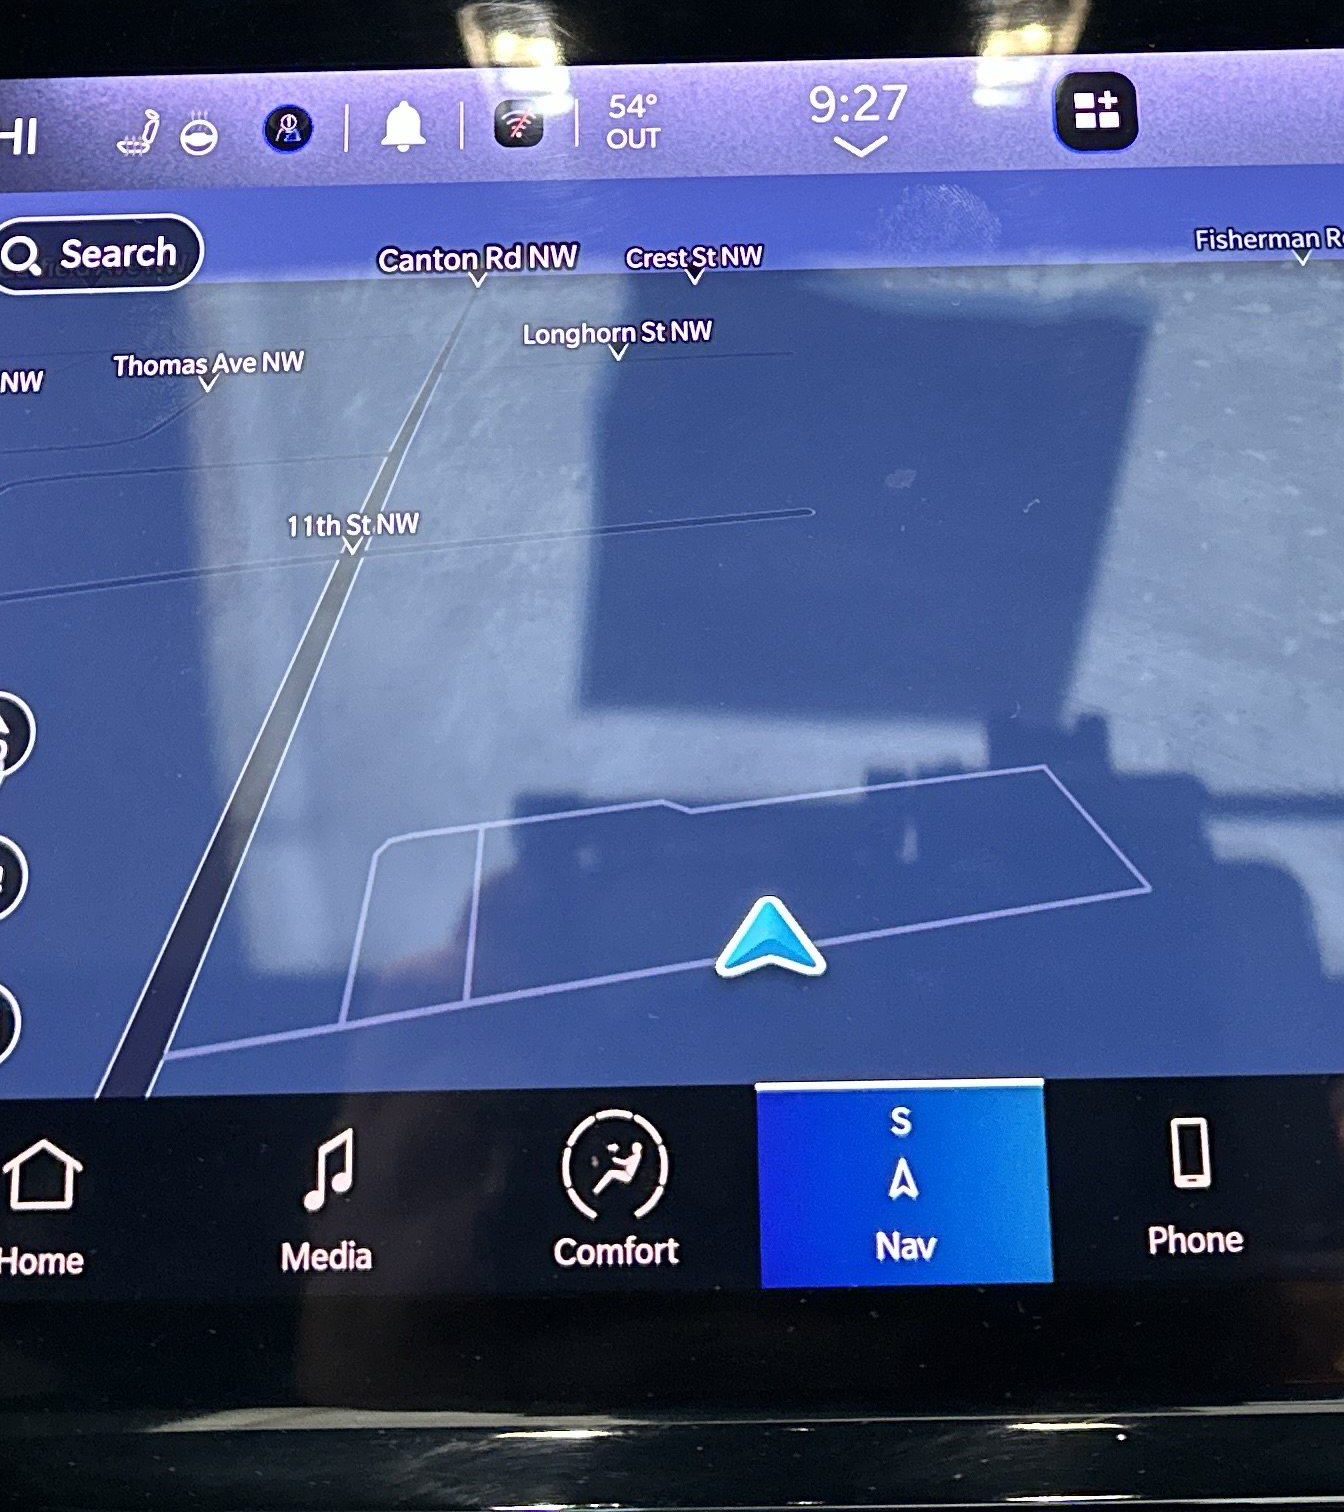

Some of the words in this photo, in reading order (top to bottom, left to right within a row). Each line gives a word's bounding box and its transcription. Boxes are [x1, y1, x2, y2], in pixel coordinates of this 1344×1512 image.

[607, 92, 659, 119] 54°
[808, 83, 908, 124] 9:27
[606, 127, 662, 150] OUT
[60, 235, 177, 269] Search
[1194, 227, 1320, 252] Fisherman
[377, 247, 478, 272] Canton
[484, 245, 522, 271] Rd
[528, 244, 579, 269] NW
[625, 247, 689, 269] Crest
[692, 246, 717, 269] St
[721, 245, 763, 268] NW
[522, 323, 636, 348] Longhorn
[641, 321, 666, 343] St
[670, 320, 713, 342] NW
[113, 354, 208, 377] Thomas
[211, 354, 257, 375] Ave
[262, 350, 305, 373] NW
[0, 370, 44, 394] NW
[288, 514, 341, 537] 11th
[346, 513, 372, 536] St
[377, 512, 420, 535] NW
[890, 1106, 912, 1137] S
[553, 1234, 680, 1267] Comfort
[875, 1230, 938, 1262] Nav
[1148, 1224, 1245, 1255] Phone
[281, 1239, 373, 1272] Media
